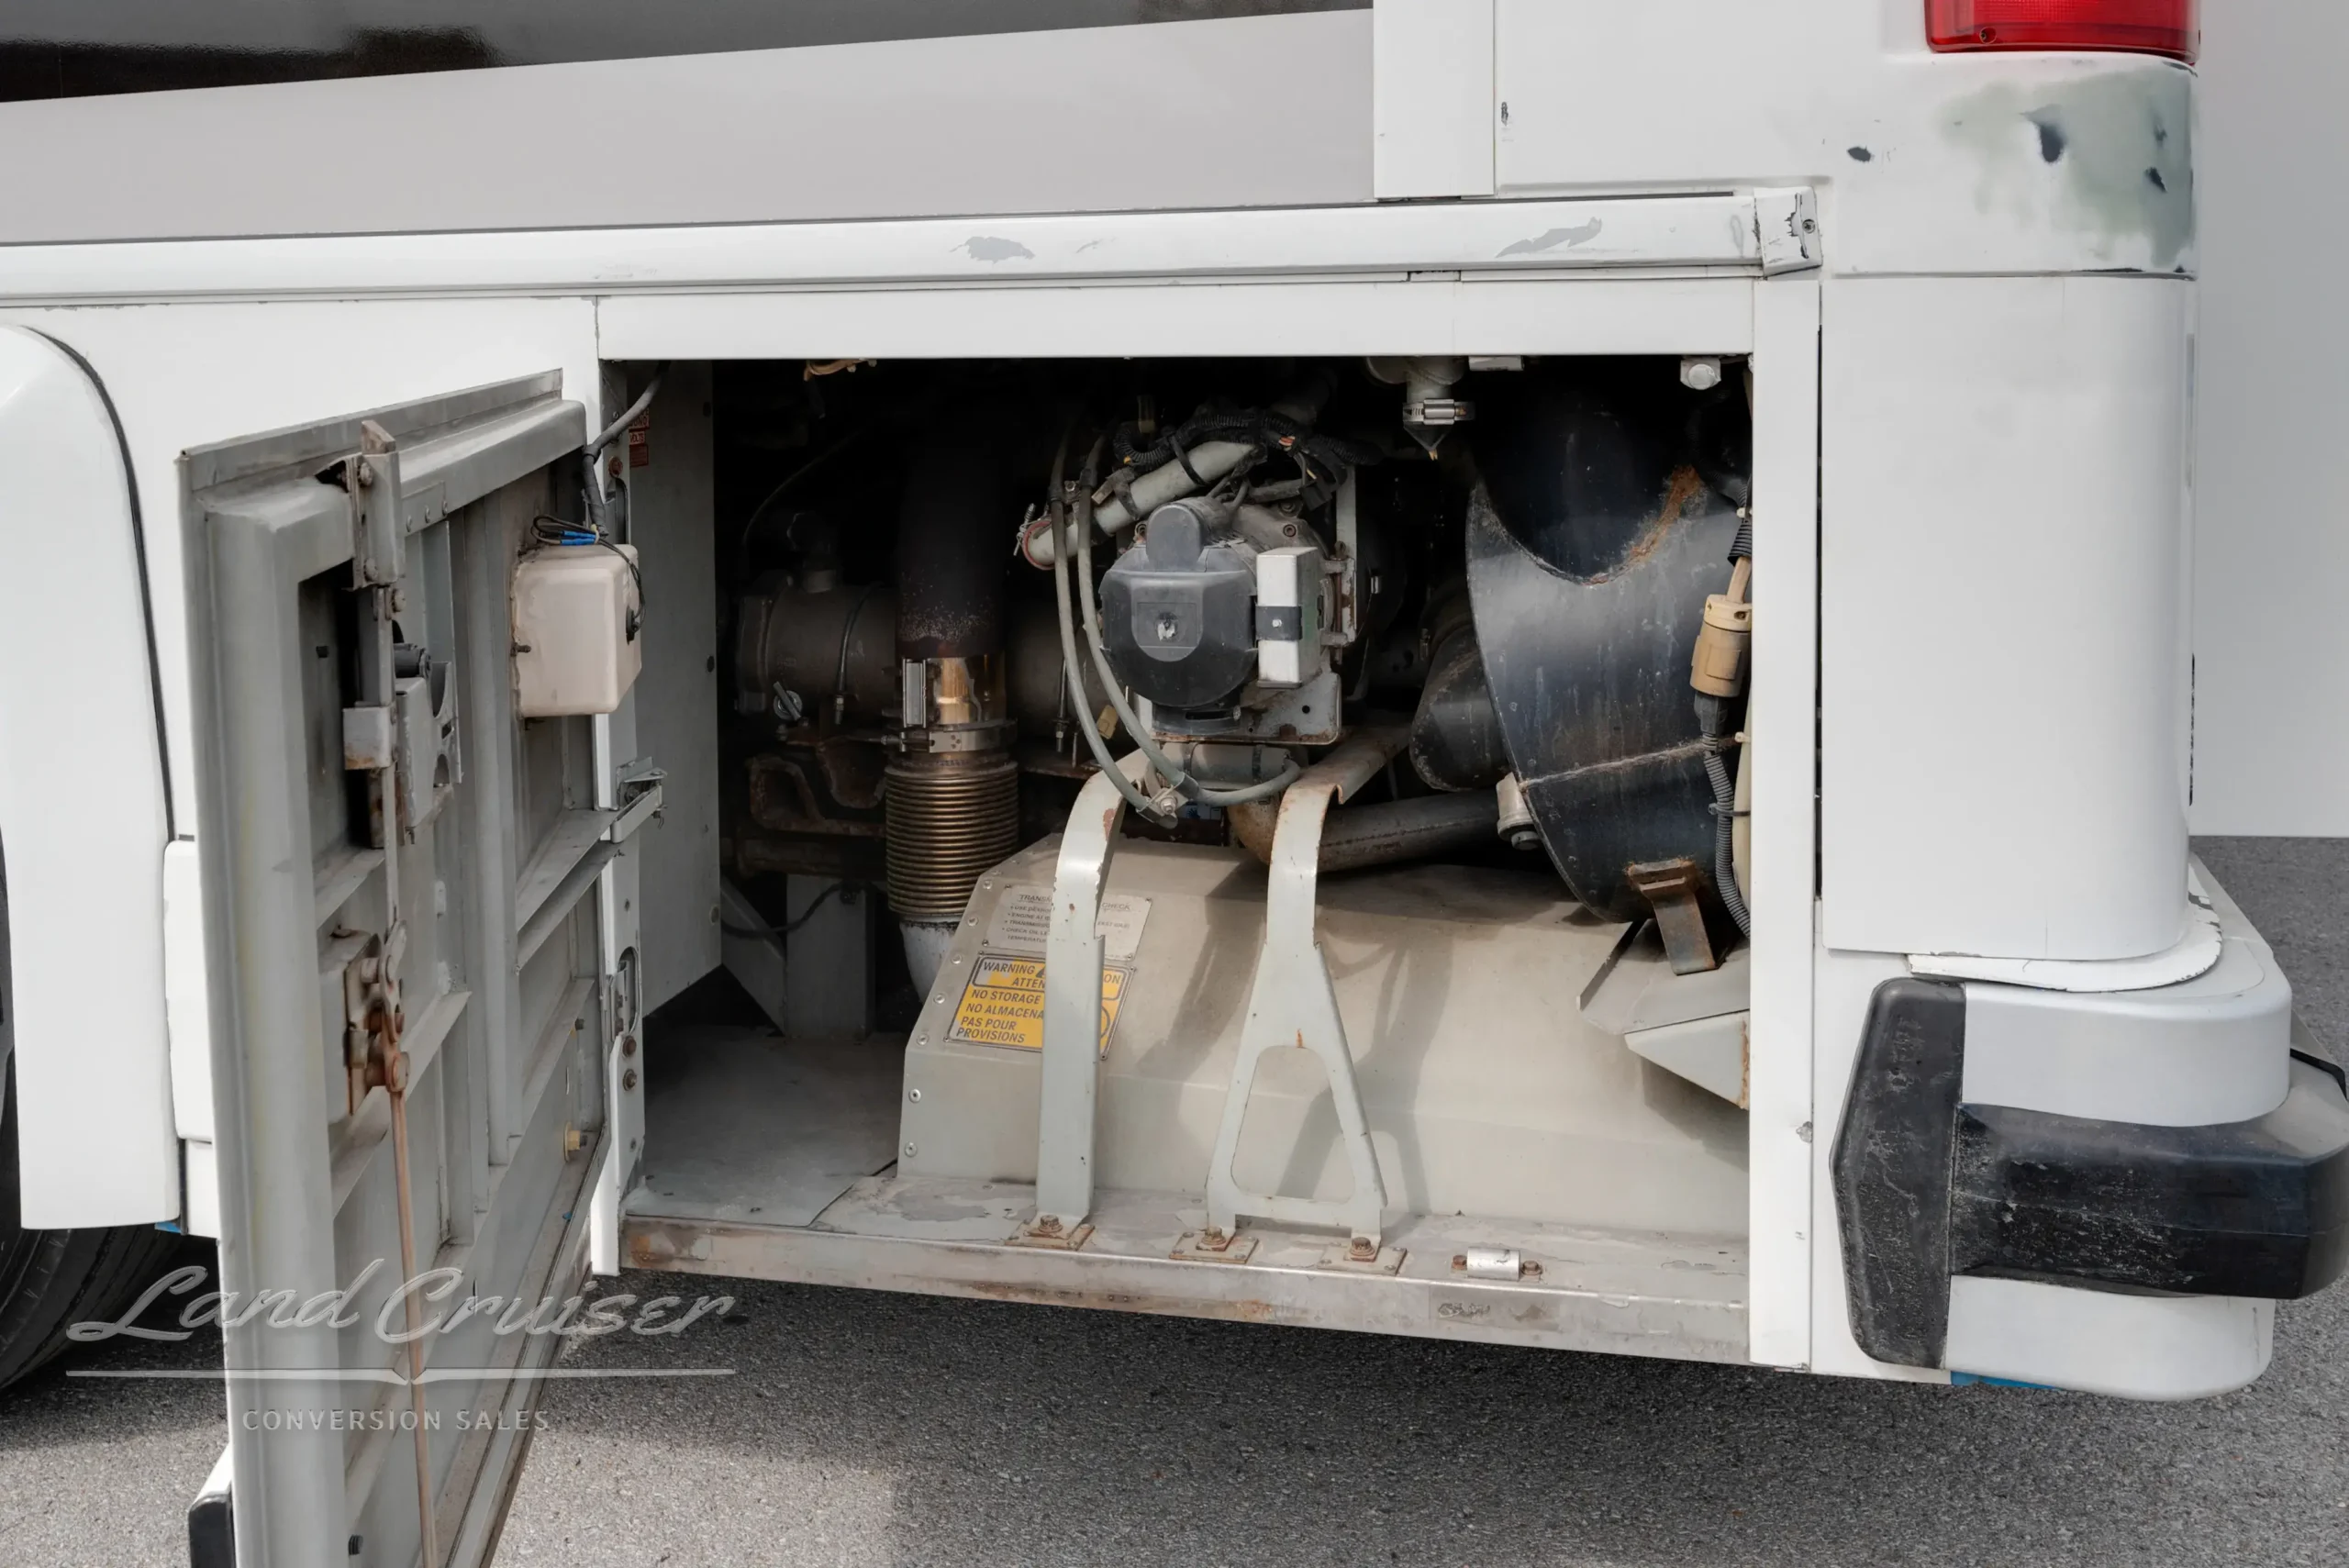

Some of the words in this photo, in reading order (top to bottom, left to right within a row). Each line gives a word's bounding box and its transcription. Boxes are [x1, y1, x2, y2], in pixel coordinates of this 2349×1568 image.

[984, 962, 1036, 974] WARNING
[1104, 973, 1121, 984] ON
[1011, 977, 1046, 989] ATTEN
[971, 989, 988, 999] NO
[990, 991, 1041, 1005] STORAGE
[965, 1003, 983, 1013] NO
[984, 1006, 1044, 1019] ALMACENA
[961, 1016, 984, 1028] PAS
[985, 1018, 1018, 1030] POUR
[956, 1027, 1026, 1043] PROVISIONS
